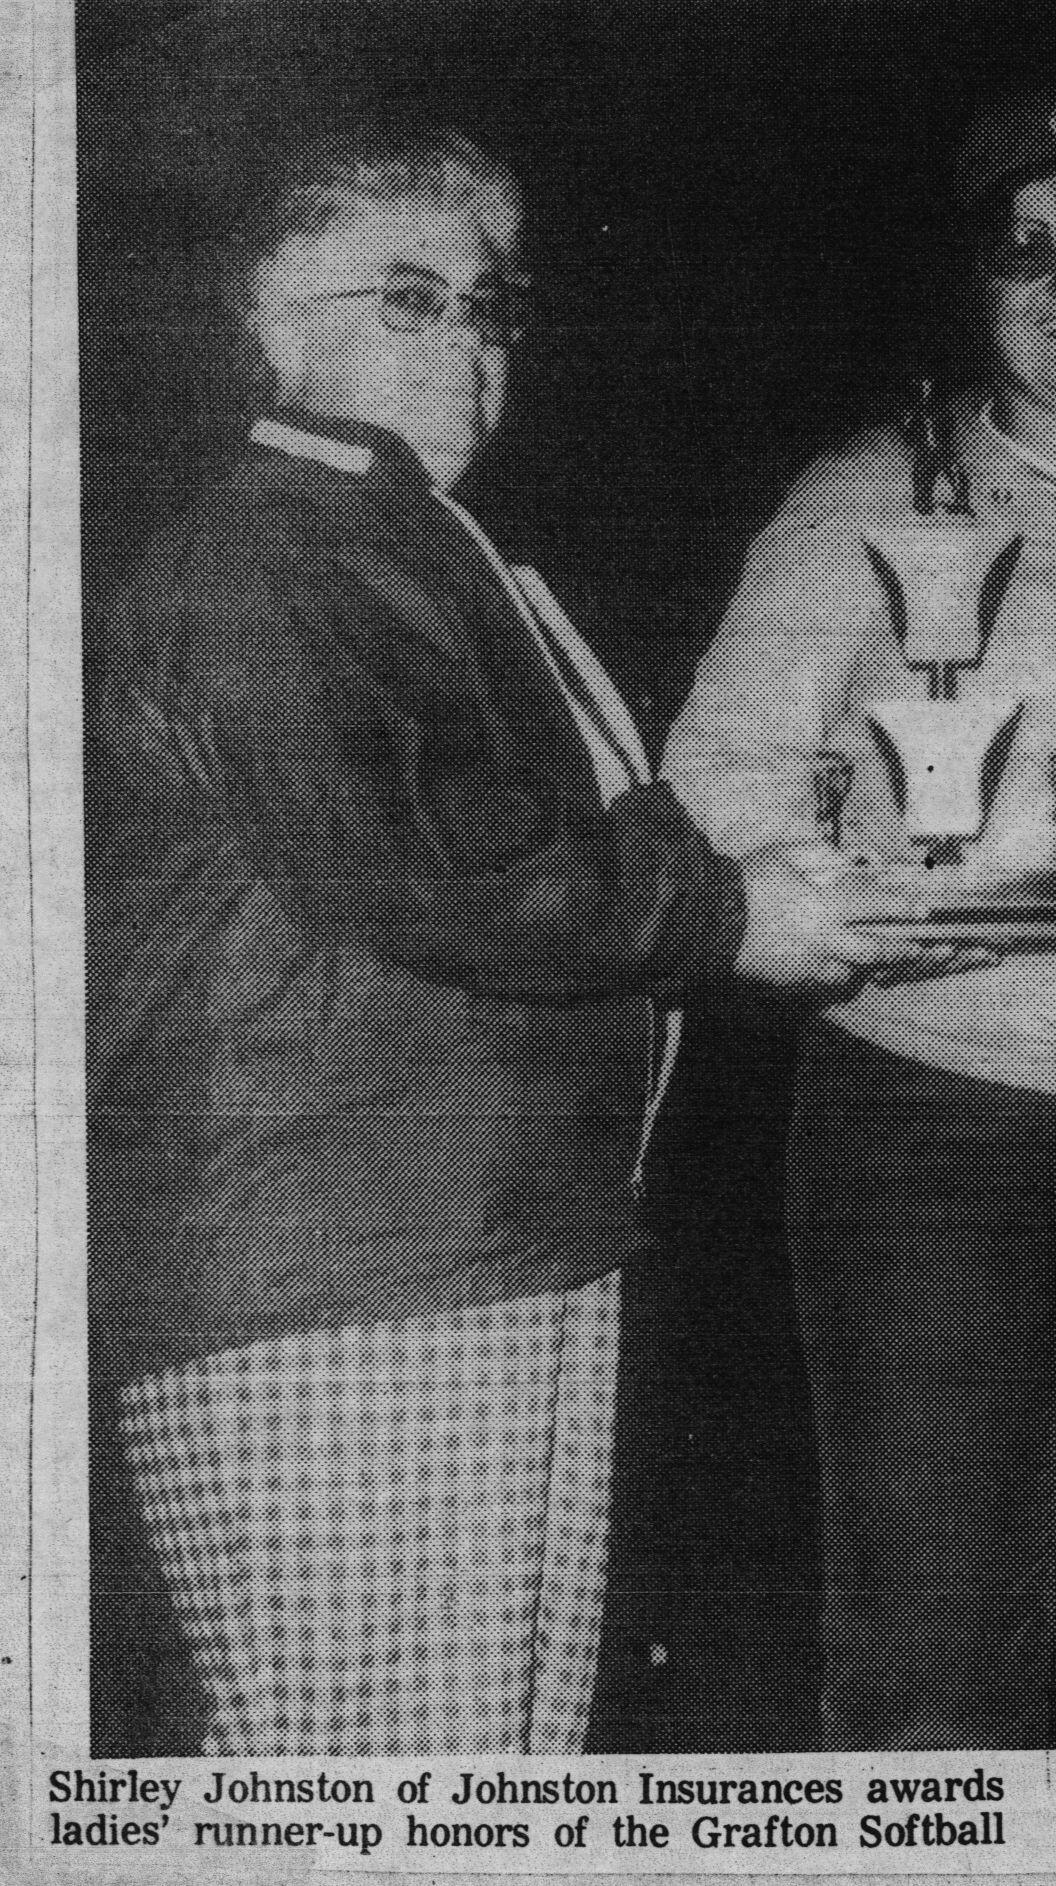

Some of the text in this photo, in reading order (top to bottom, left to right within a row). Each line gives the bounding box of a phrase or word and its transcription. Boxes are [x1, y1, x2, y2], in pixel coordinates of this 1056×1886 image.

[49, 1768, 1005, 1811] Shirley Johnston of Johnston Insurances awards
[50, 1811, 1006, 1855] ladies' runner-up honors of the Grafton Softball
